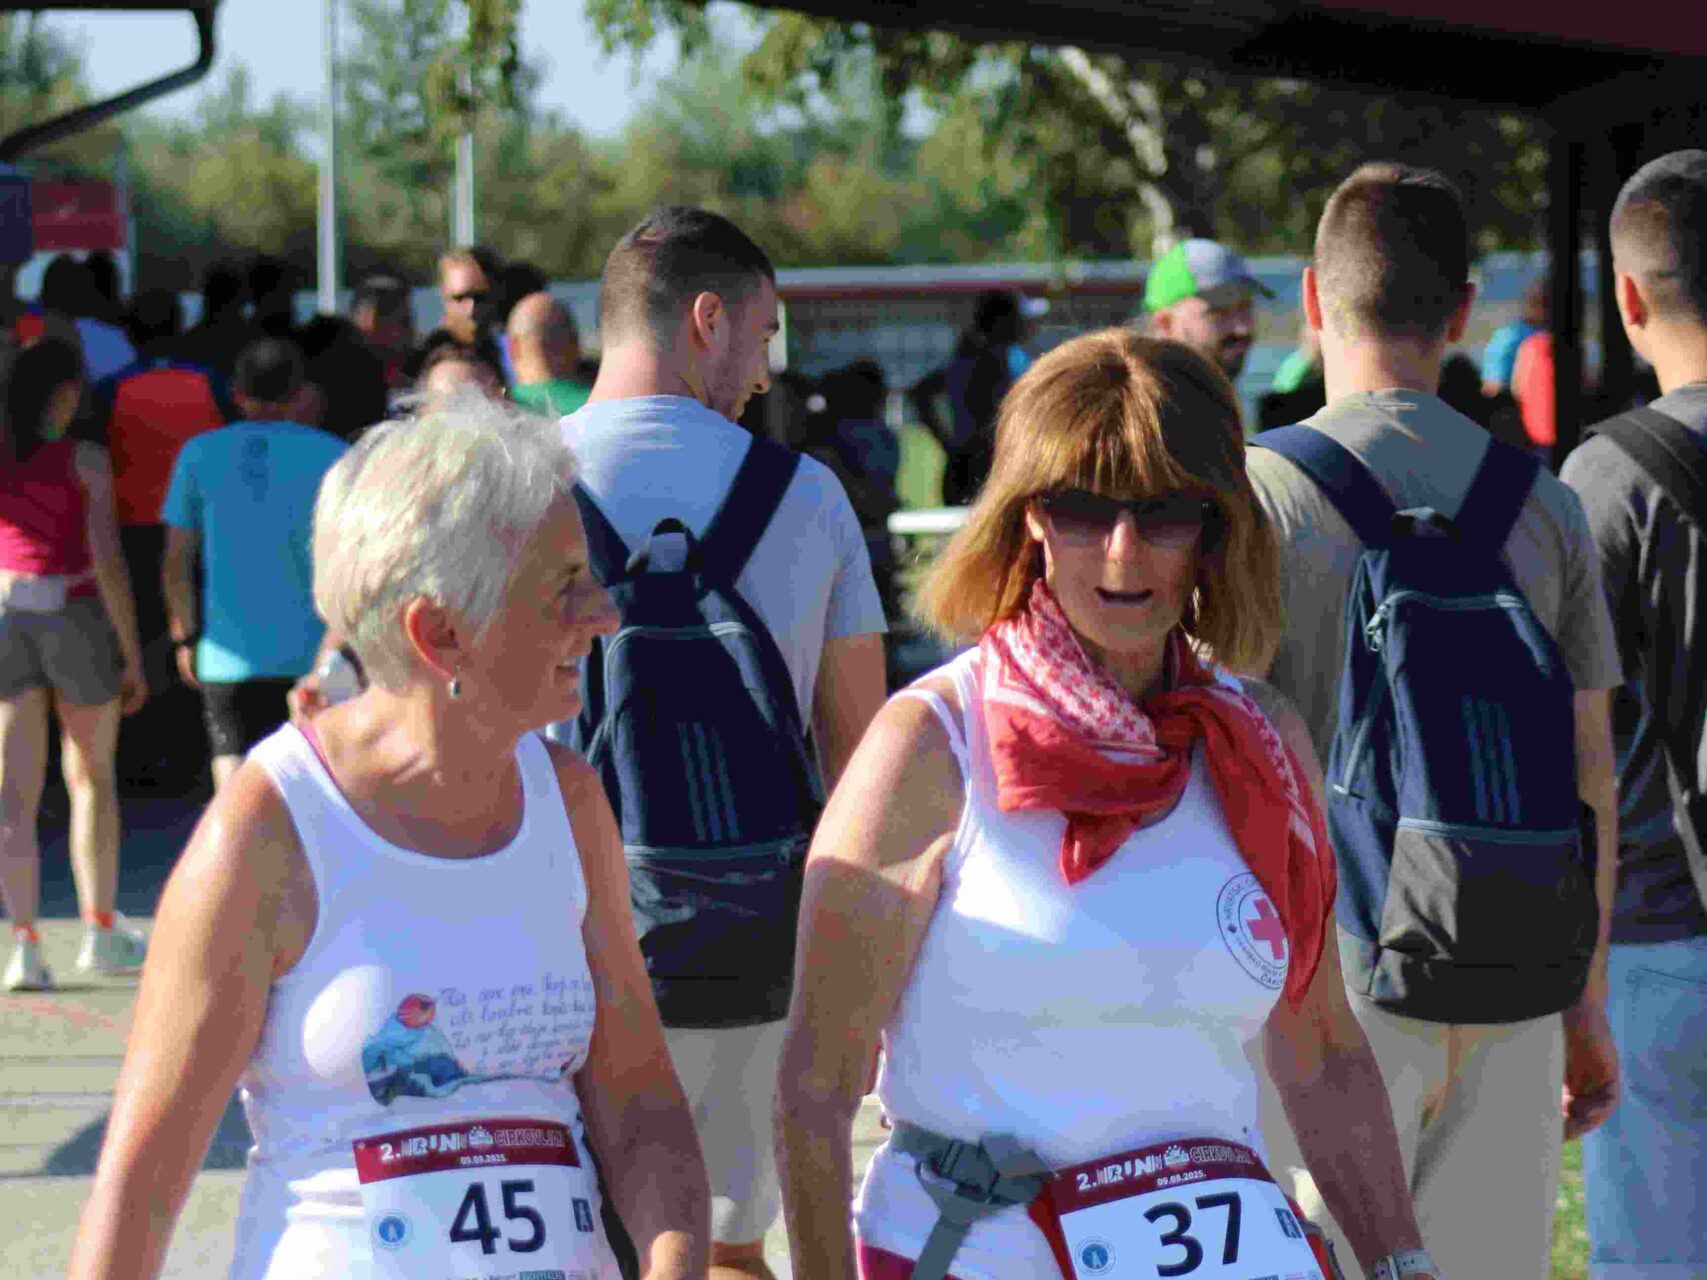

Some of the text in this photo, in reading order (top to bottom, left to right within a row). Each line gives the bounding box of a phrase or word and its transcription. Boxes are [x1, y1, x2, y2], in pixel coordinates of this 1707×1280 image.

[380, 1142, 401, 1162] 2.
[1075, 1171, 1098, 1191] 2.
[1156, 1169, 1207, 1187] 09.08.2025.
[450, 1179, 546, 1254] 45
[1143, 1191, 1242, 1277] 37
